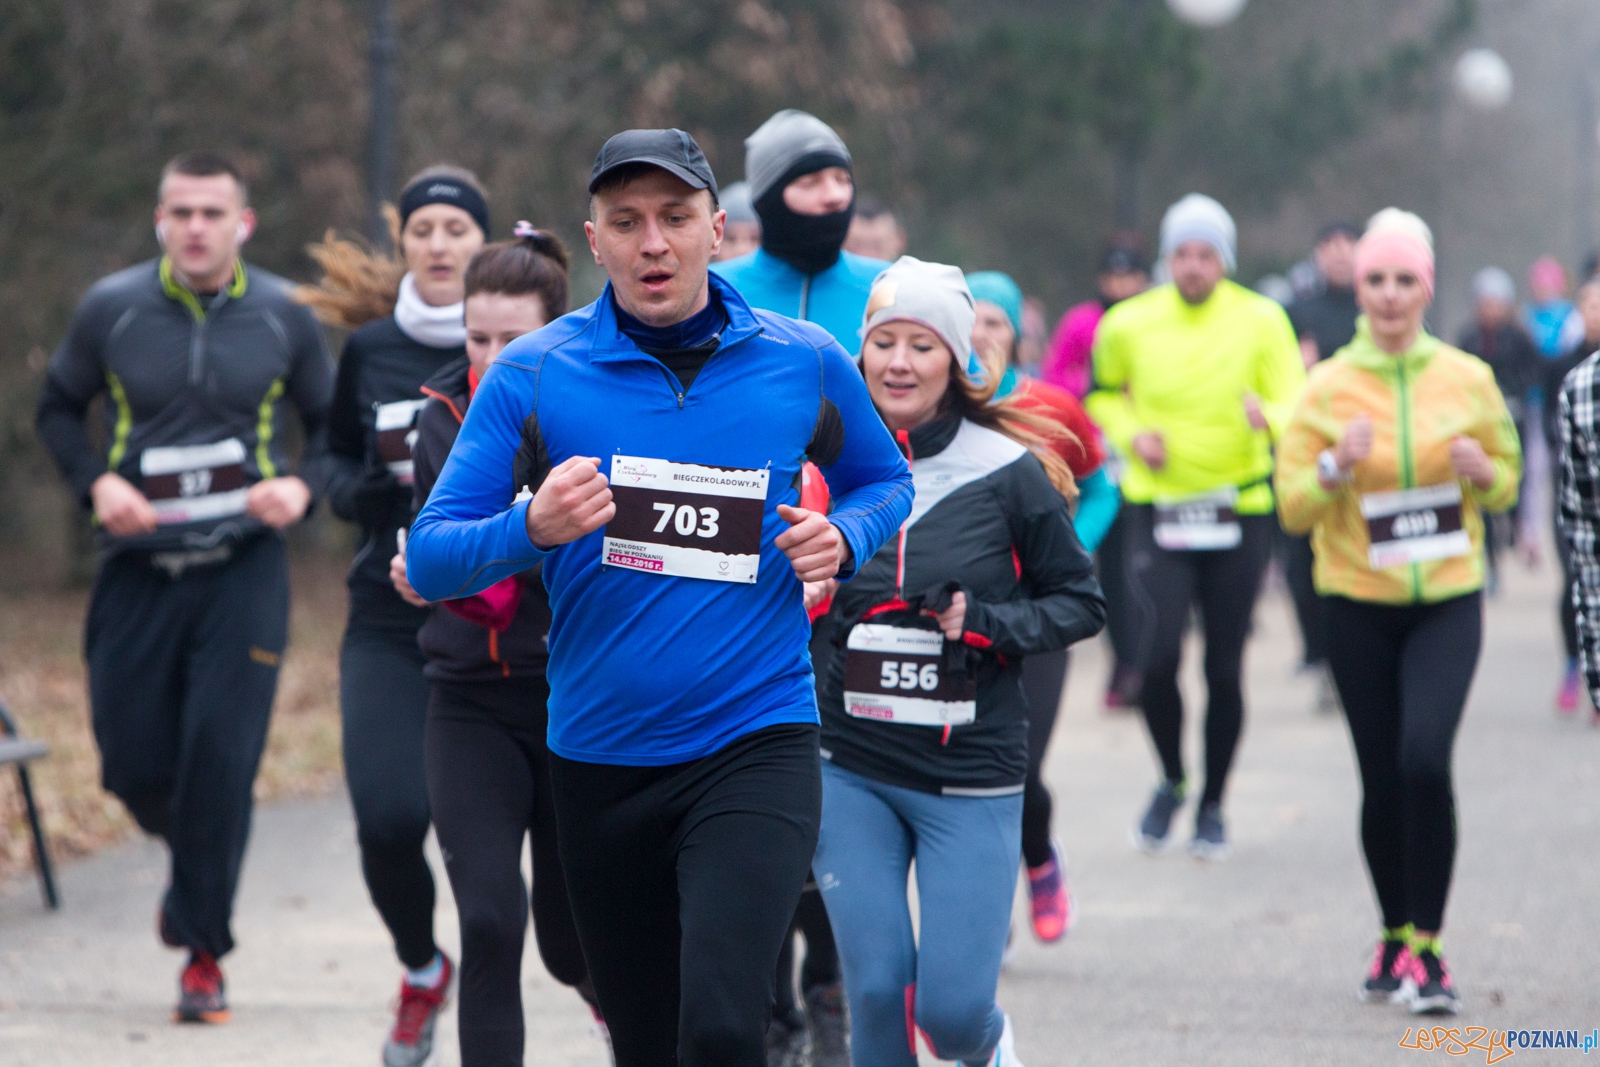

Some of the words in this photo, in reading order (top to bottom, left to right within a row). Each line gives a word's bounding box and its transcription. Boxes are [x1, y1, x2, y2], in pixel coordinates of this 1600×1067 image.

[759, 333, 789, 346] uechua
[673, 473, 761, 489] BIEGCZEKOLADOWY.PL
[652, 501, 720, 539] 703
[609, 541, 647, 552] NAJSŁODSZY
[609, 547, 623, 555] BIEG
[631, 550, 664, 561] POZNANIU
[610, 554, 654, 569] 14.02.2016
[880, 660, 939, 692] 556
